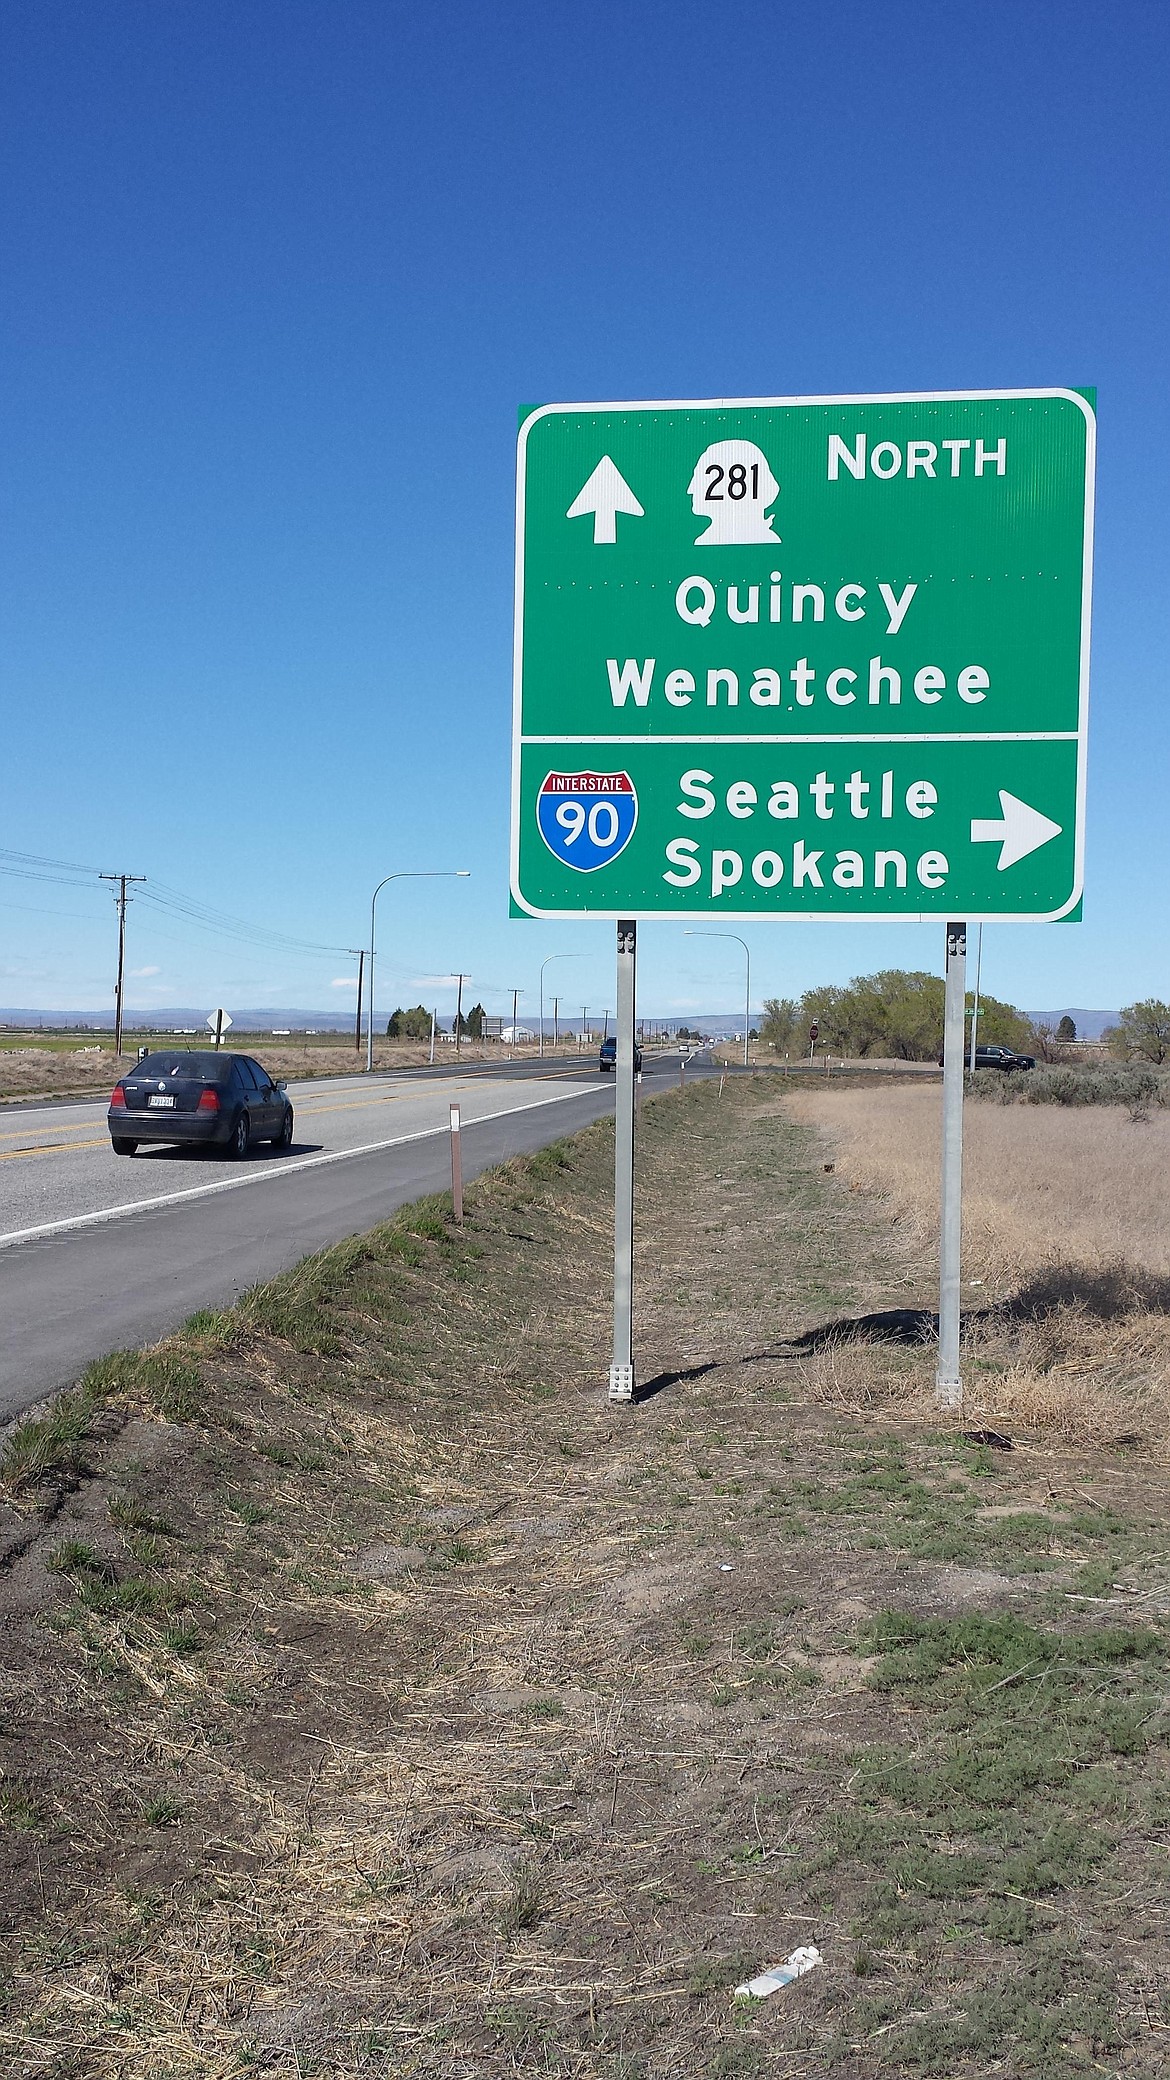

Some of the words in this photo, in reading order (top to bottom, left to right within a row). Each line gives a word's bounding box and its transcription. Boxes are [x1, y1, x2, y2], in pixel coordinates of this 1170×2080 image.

[827, 433, 1006, 481] NORTH
[704, 463, 759, 501] 281
[675, 571, 918, 634] Quincy
[606, 655, 990, 707] Wenatchee
[552, 777, 623, 791] INTERSTATE
[676, 769, 938, 820] Seattle
[555, 801, 619, 847] 90
[662, 837, 949, 897] Spokane
